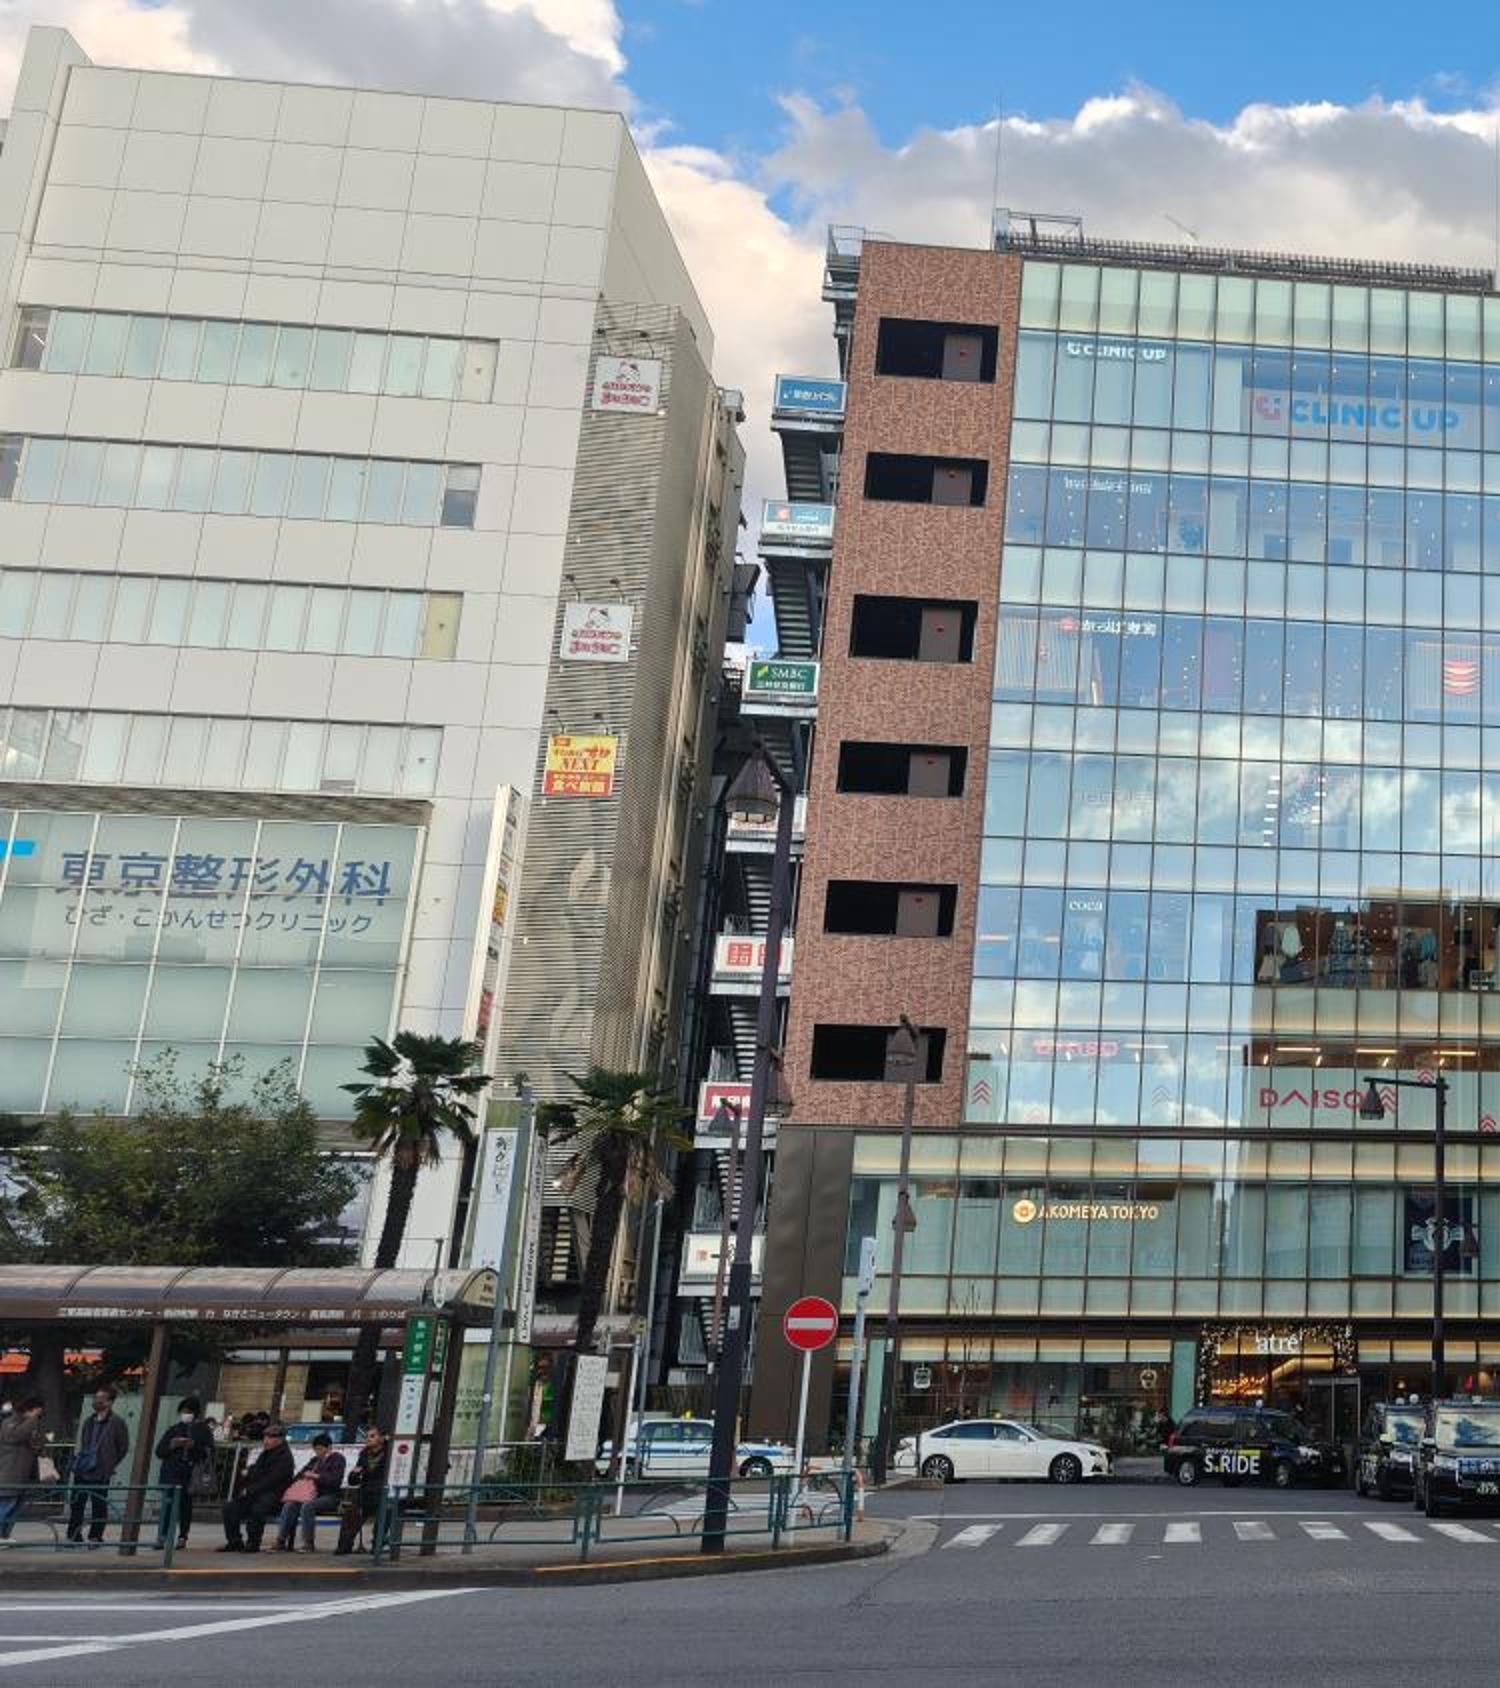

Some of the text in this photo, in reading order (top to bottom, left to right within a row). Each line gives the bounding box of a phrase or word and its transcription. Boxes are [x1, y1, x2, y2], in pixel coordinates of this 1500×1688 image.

[1083, 344, 1166, 360] CLINIC UP
[1291, 398, 1460, 432] CLINIC UP
[770, 665, 809, 680] SMBC
[57, 849, 391, 907] 東京整形外科
[1068, 900, 1103, 911] coca
[64, 903, 374, 935] ひざ・こかんせつクリニック
[1259, 1087, 1366, 1111] DAISO
[1038, 1204, 1160, 1221] AKOMEYA TOKYO
[1256, 1331, 1300, 1353] atré
[1204, 1454, 1261, 1475] S.RIDE
